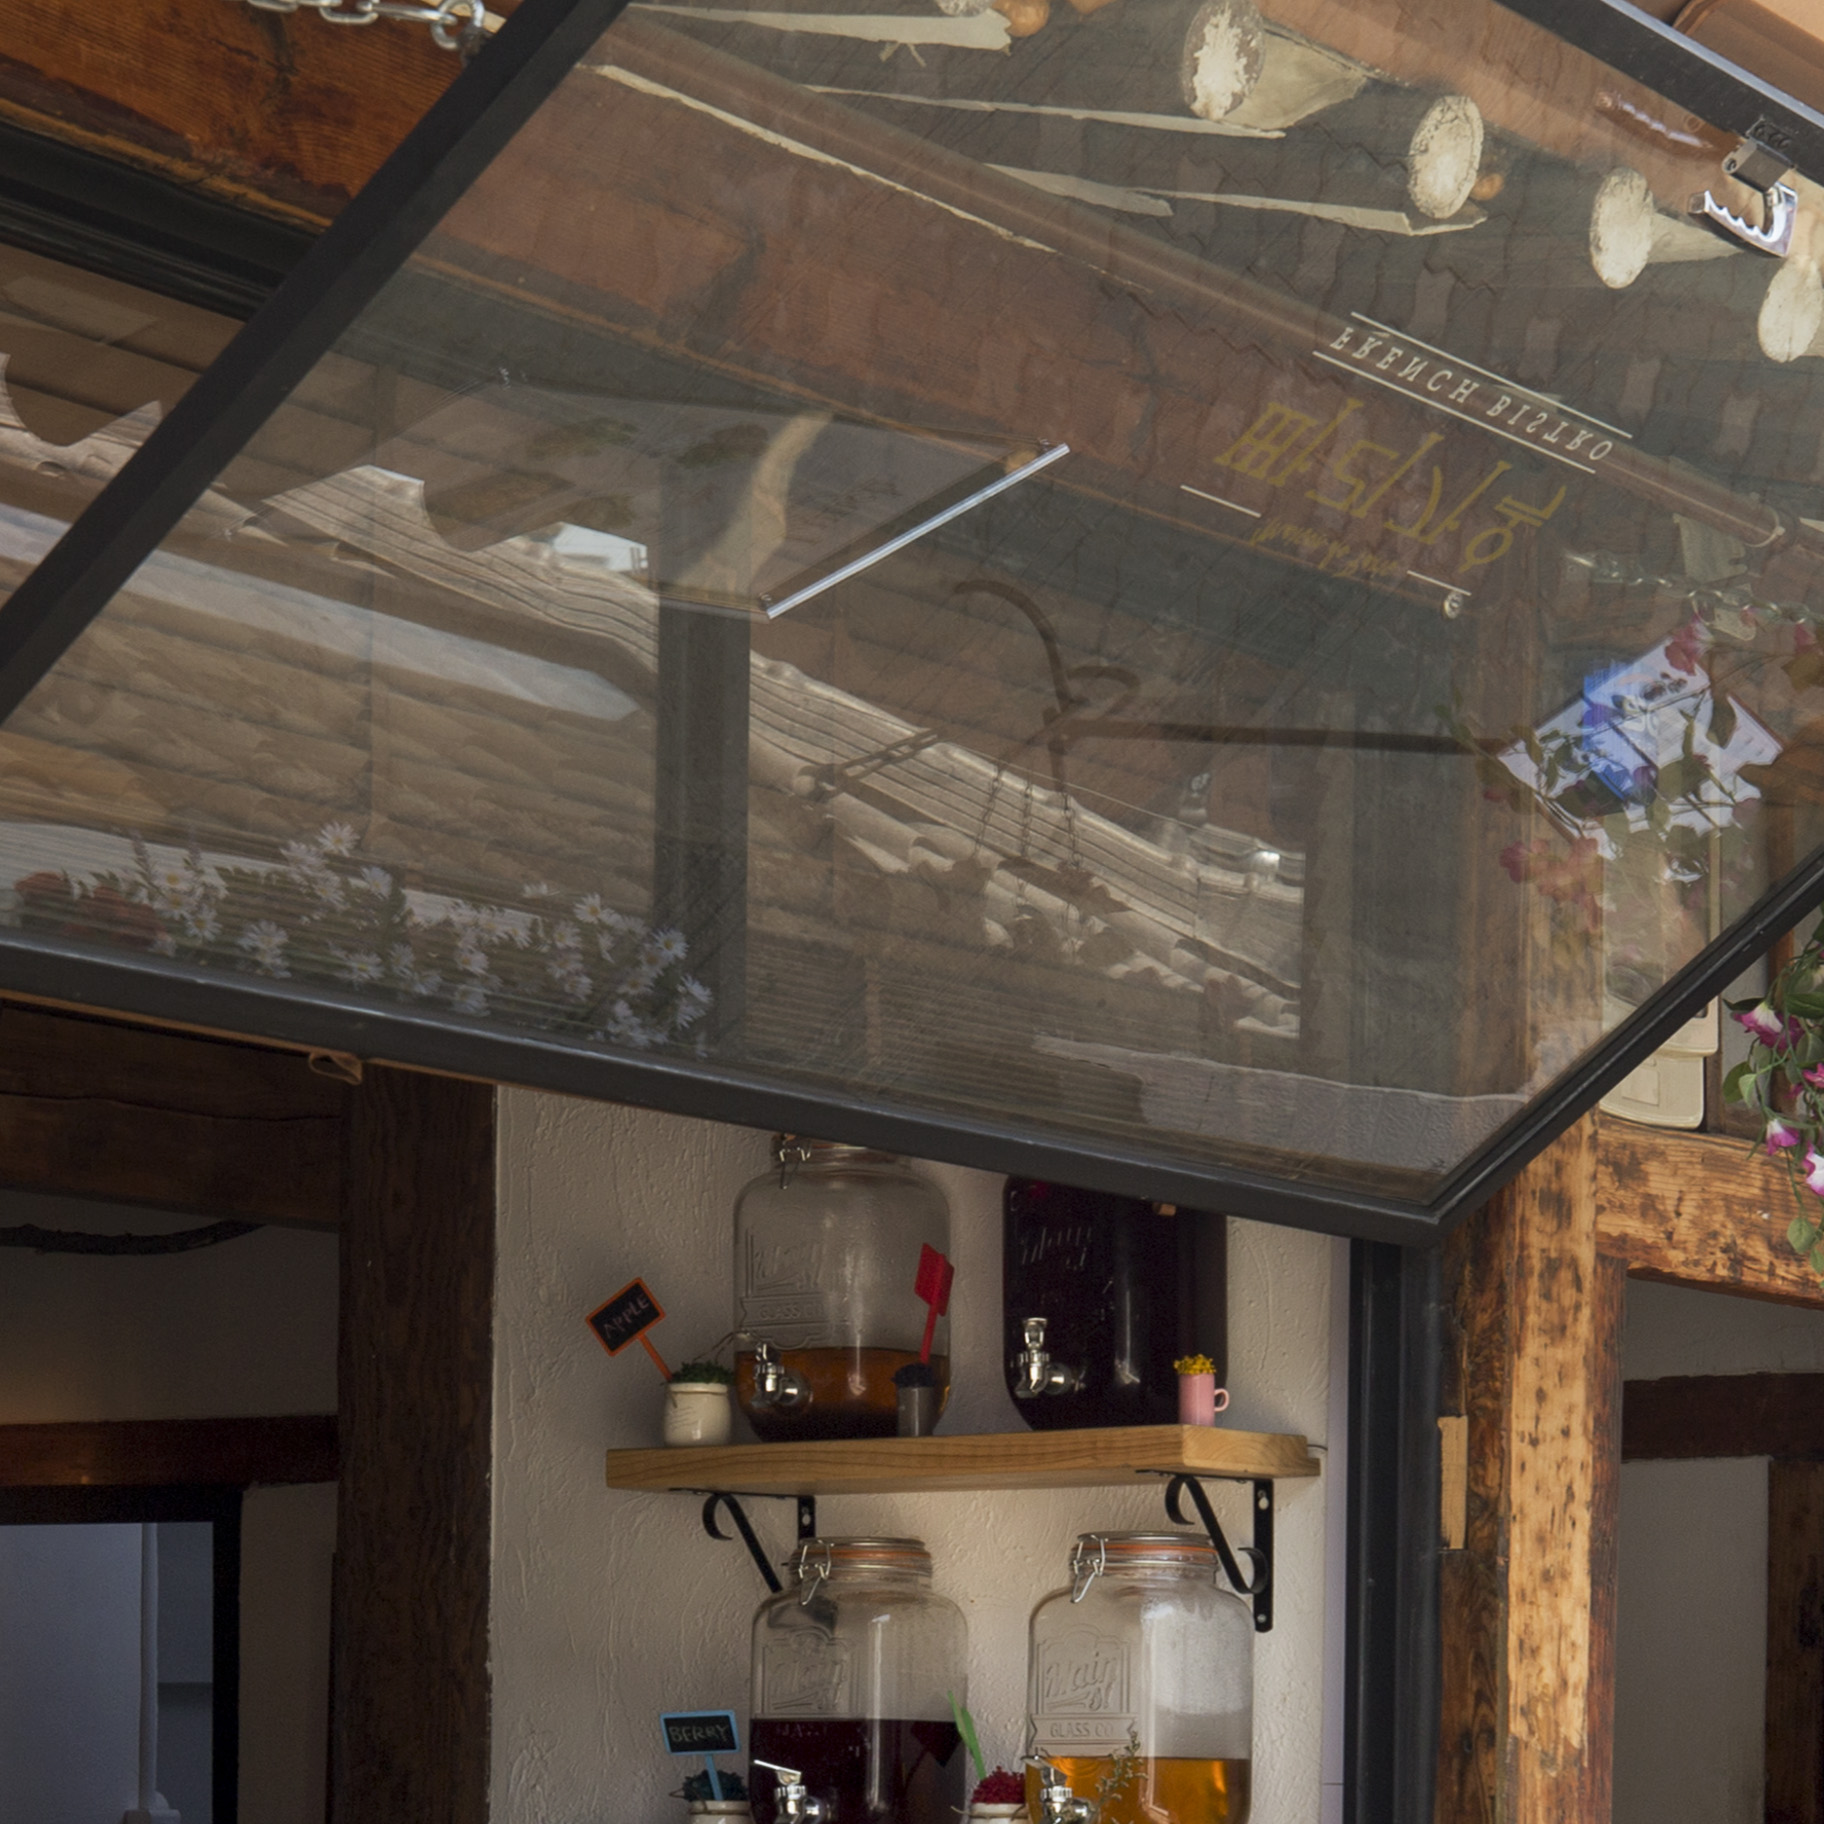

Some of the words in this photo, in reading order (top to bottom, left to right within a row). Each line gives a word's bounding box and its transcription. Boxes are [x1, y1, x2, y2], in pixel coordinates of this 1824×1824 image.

[603, 1295, 650, 1339] APPLE
[669, 1724, 728, 1742] BERRY
[1050, 1722, 1090, 1738] GLASS
